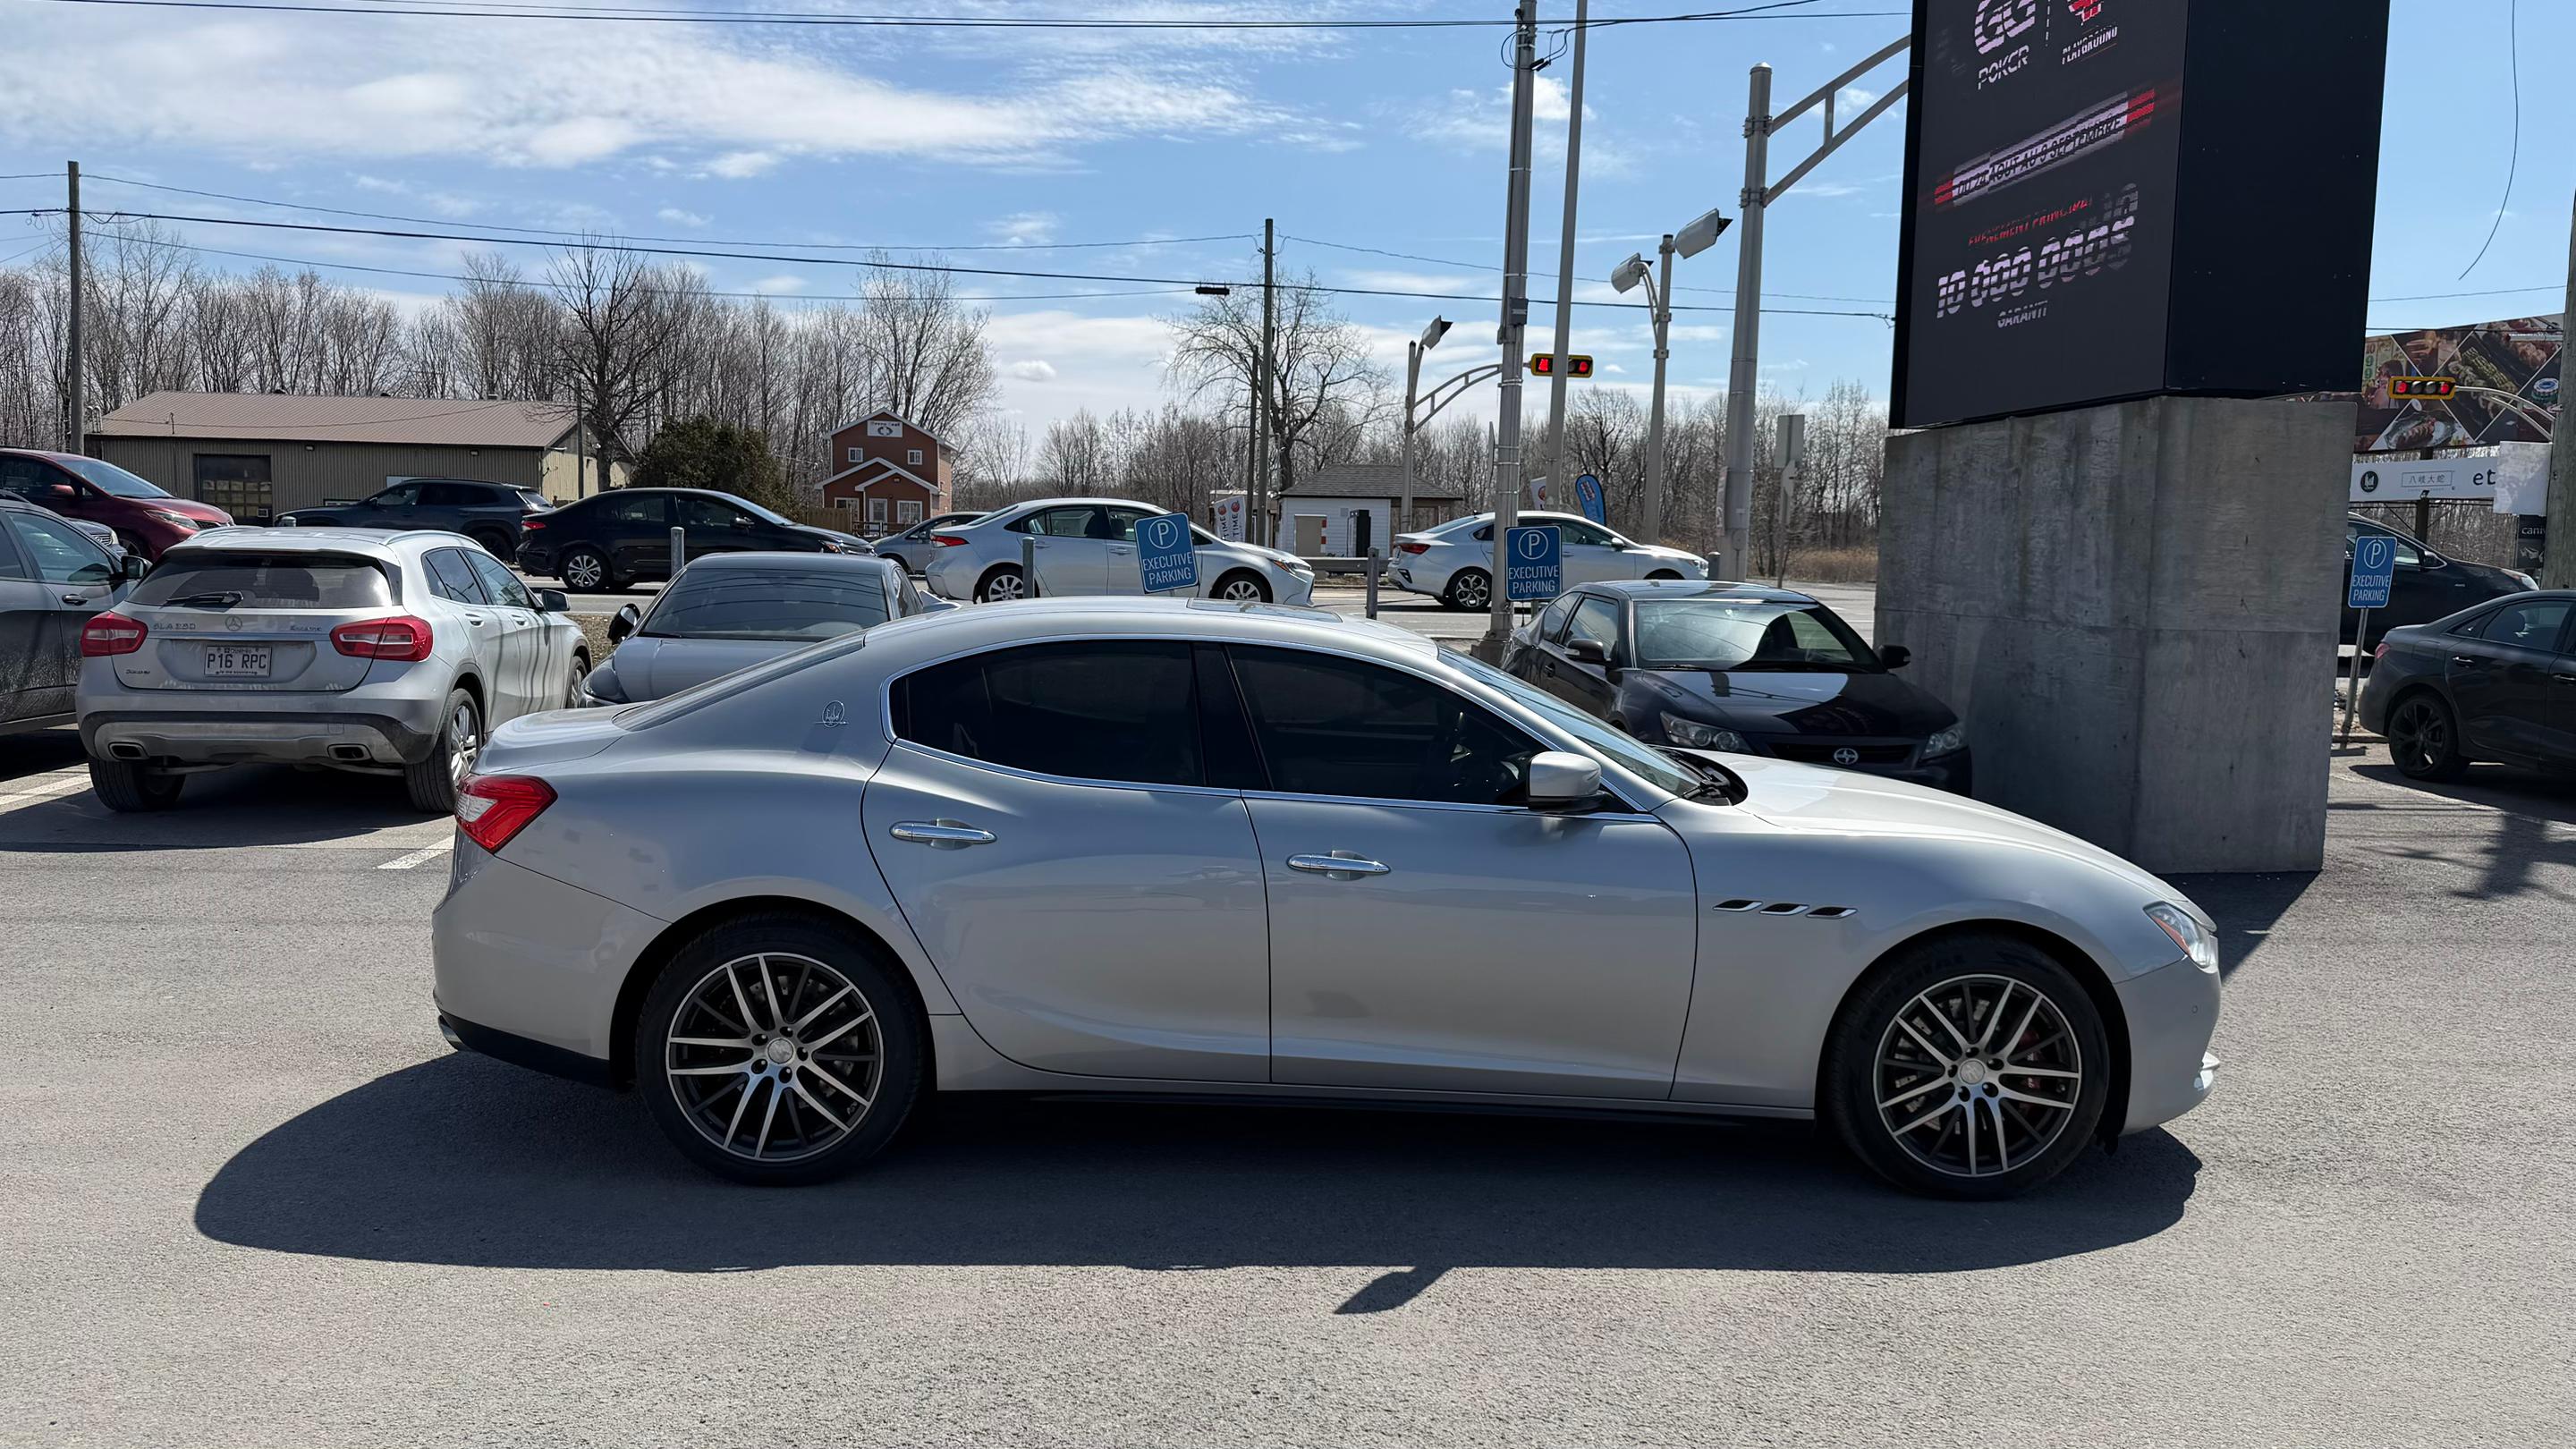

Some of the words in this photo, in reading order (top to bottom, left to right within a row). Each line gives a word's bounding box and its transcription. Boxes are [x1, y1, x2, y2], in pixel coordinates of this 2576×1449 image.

[1977, 45, 2029, 89] POKER
[1997, 300, 2049, 328] GARANTI
[1157, 522, 1169, 546] P
[1529, 533, 1540, 556] P
[1142, 552, 1193, 571] EXECUTIVE
[2370, 543, 2381, 565] P
[1148, 567, 1191, 585] PARKING
[1508, 565, 1559, 580] EXECUTIVE
[2352, 574, 2391, 587] EXECUTIVE
[1513, 580, 1555, 594] PARKING
[2353, 589, 2385, 601] PARKING
[207, 653, 233, 668] P16
[242, 654, 267, 668] RPC
